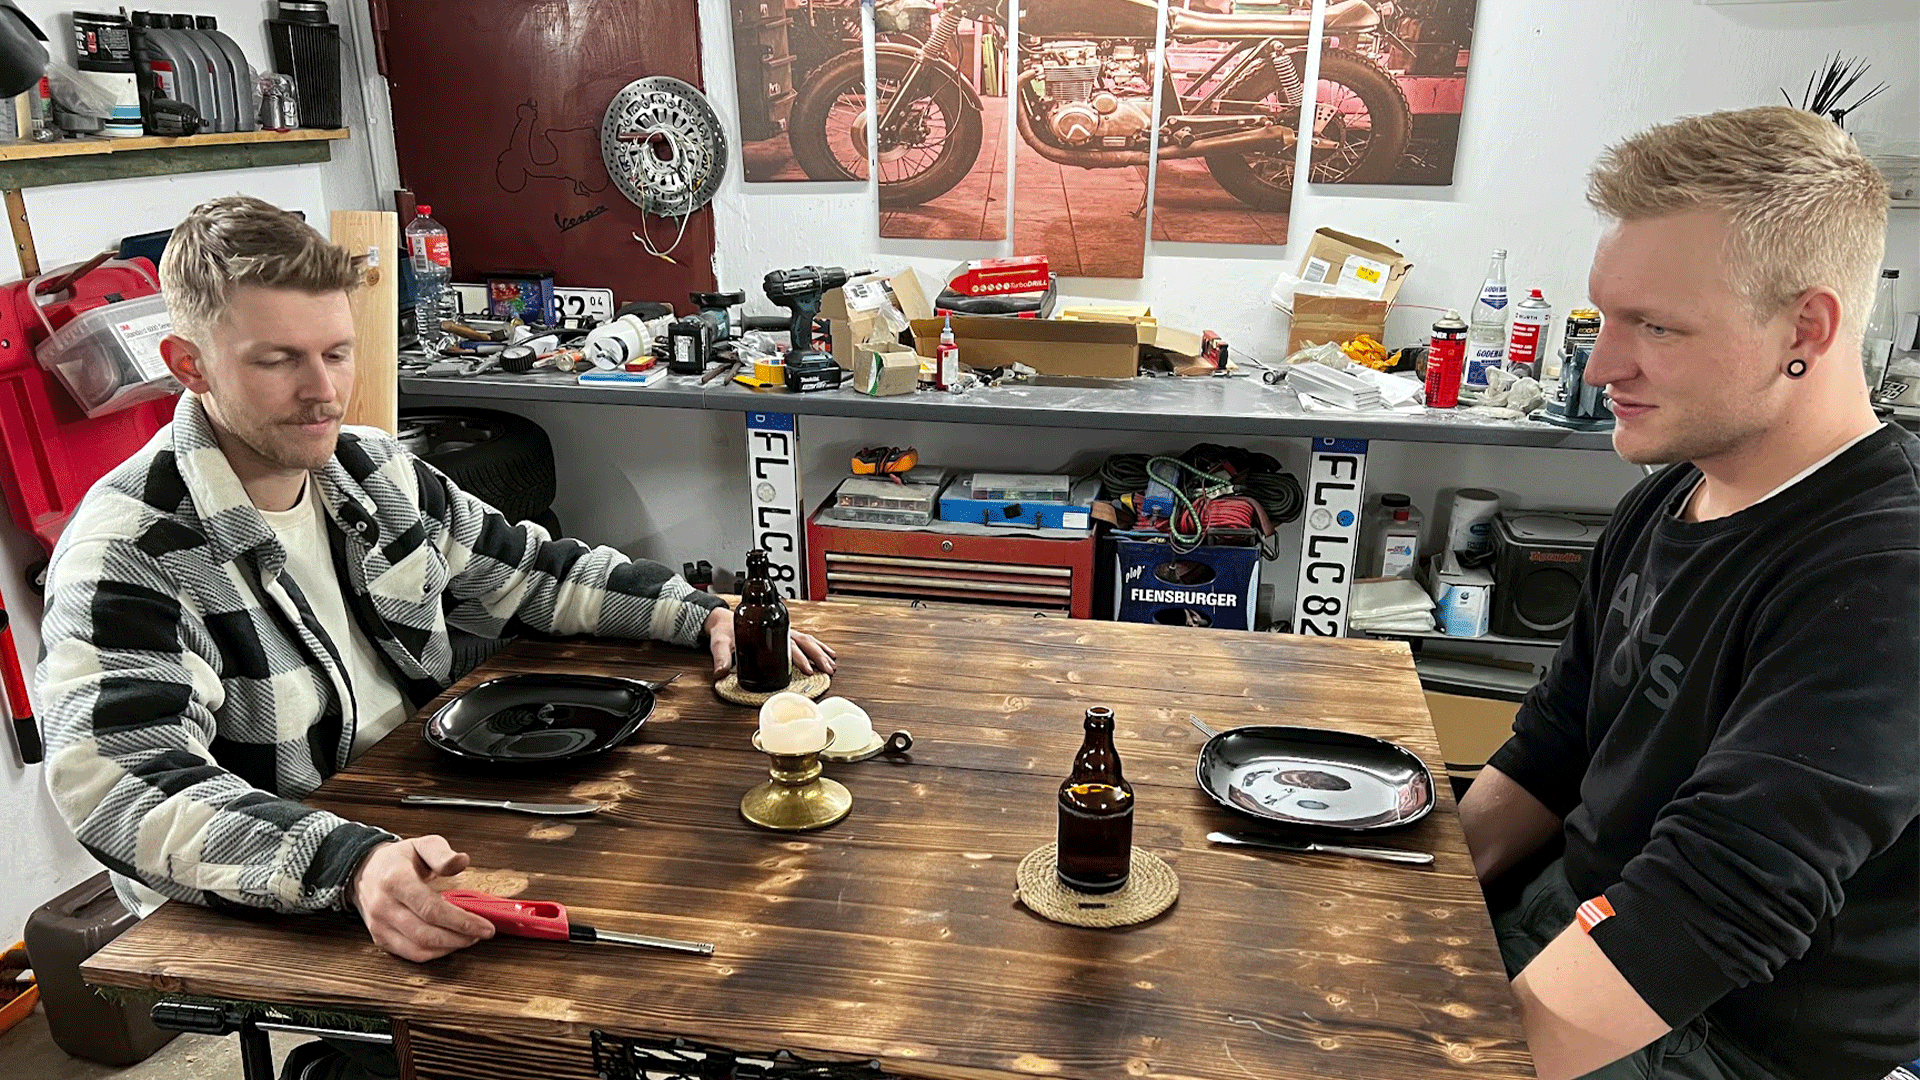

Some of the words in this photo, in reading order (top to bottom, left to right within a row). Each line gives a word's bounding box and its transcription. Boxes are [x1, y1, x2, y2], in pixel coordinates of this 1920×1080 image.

[554, 204, 609, 233] Vespa
[1010, 280, 1048, 289] TurboDRILL
[590, 296, 603, 306] 04
[754, 431, 789, 479] FL
[1314, 455, 1358, 506] FL
[1131, 588, 1238, 607] FLENSBURGER
